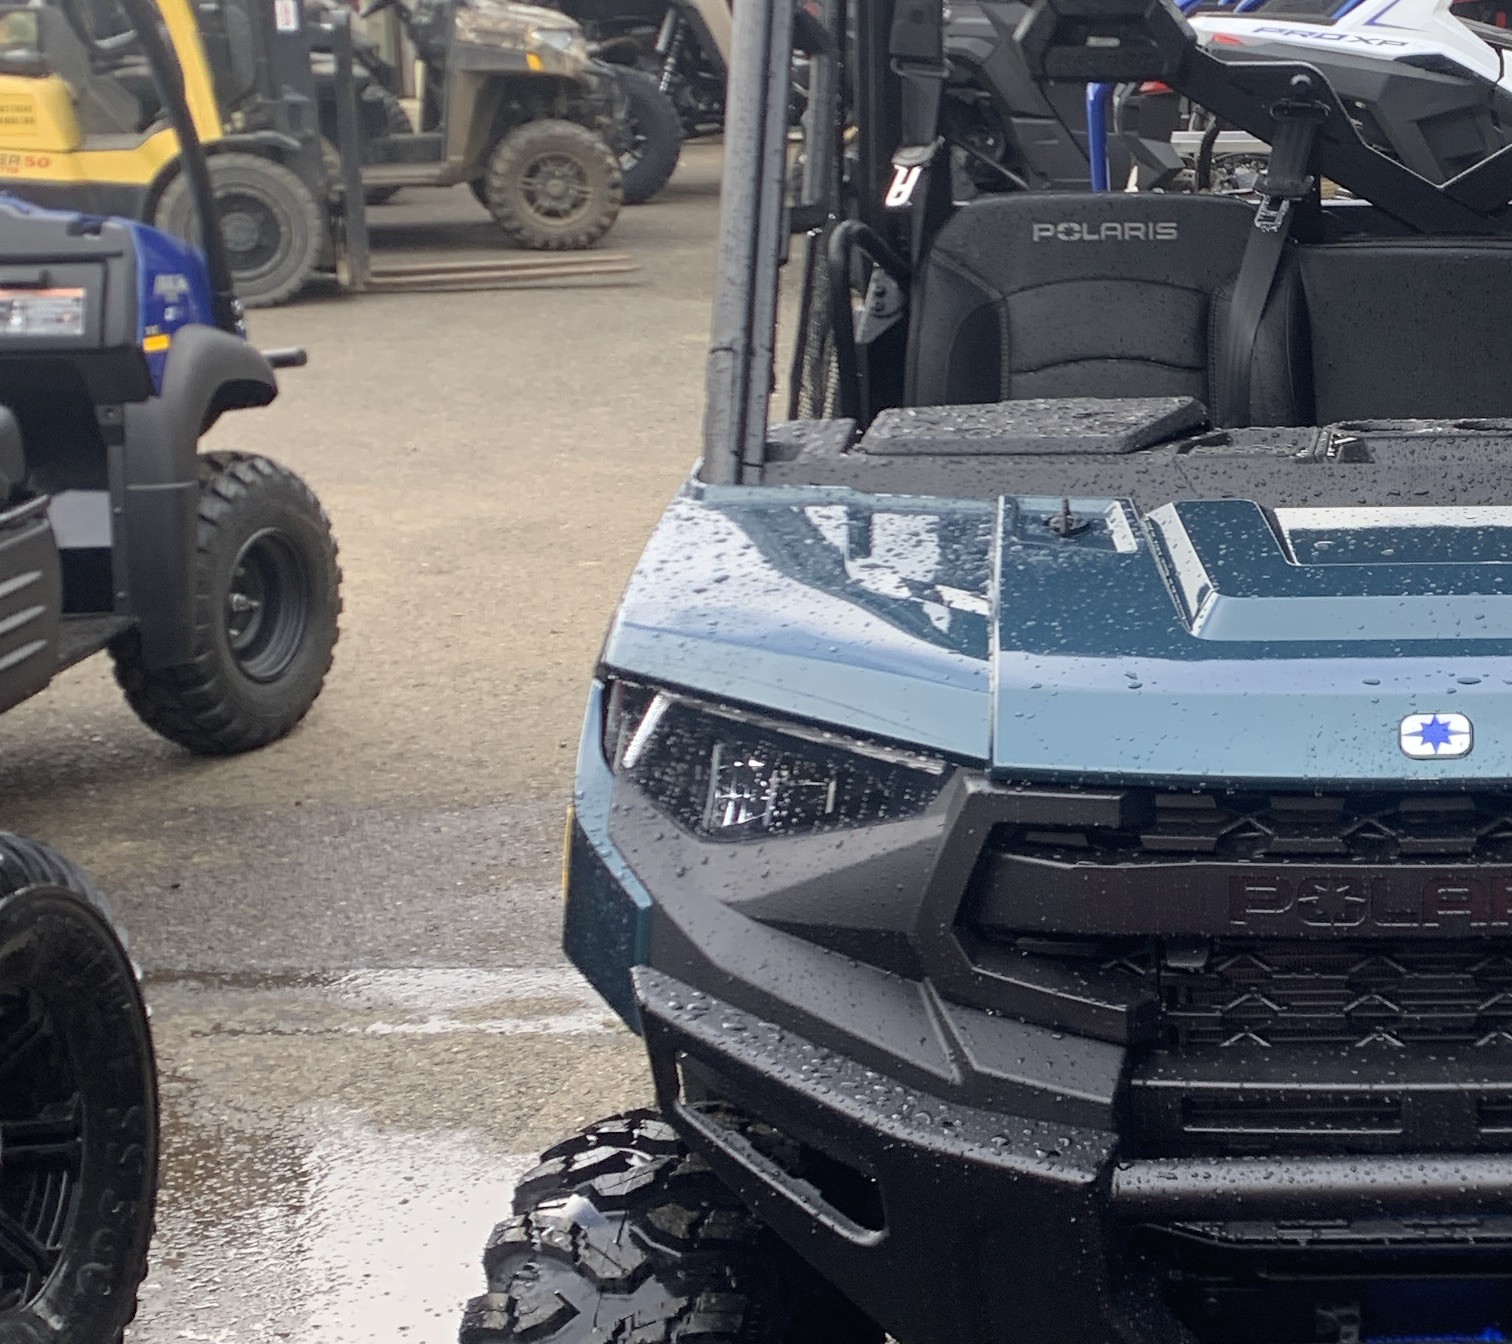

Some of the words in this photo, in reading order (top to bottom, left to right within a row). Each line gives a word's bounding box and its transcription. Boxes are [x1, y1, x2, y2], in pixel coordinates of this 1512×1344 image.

[1253, 27, 1346, 40] PRO
[1345, 35, 1408, 47] XP
[1033, 222, 1178, 242] POLARIS
